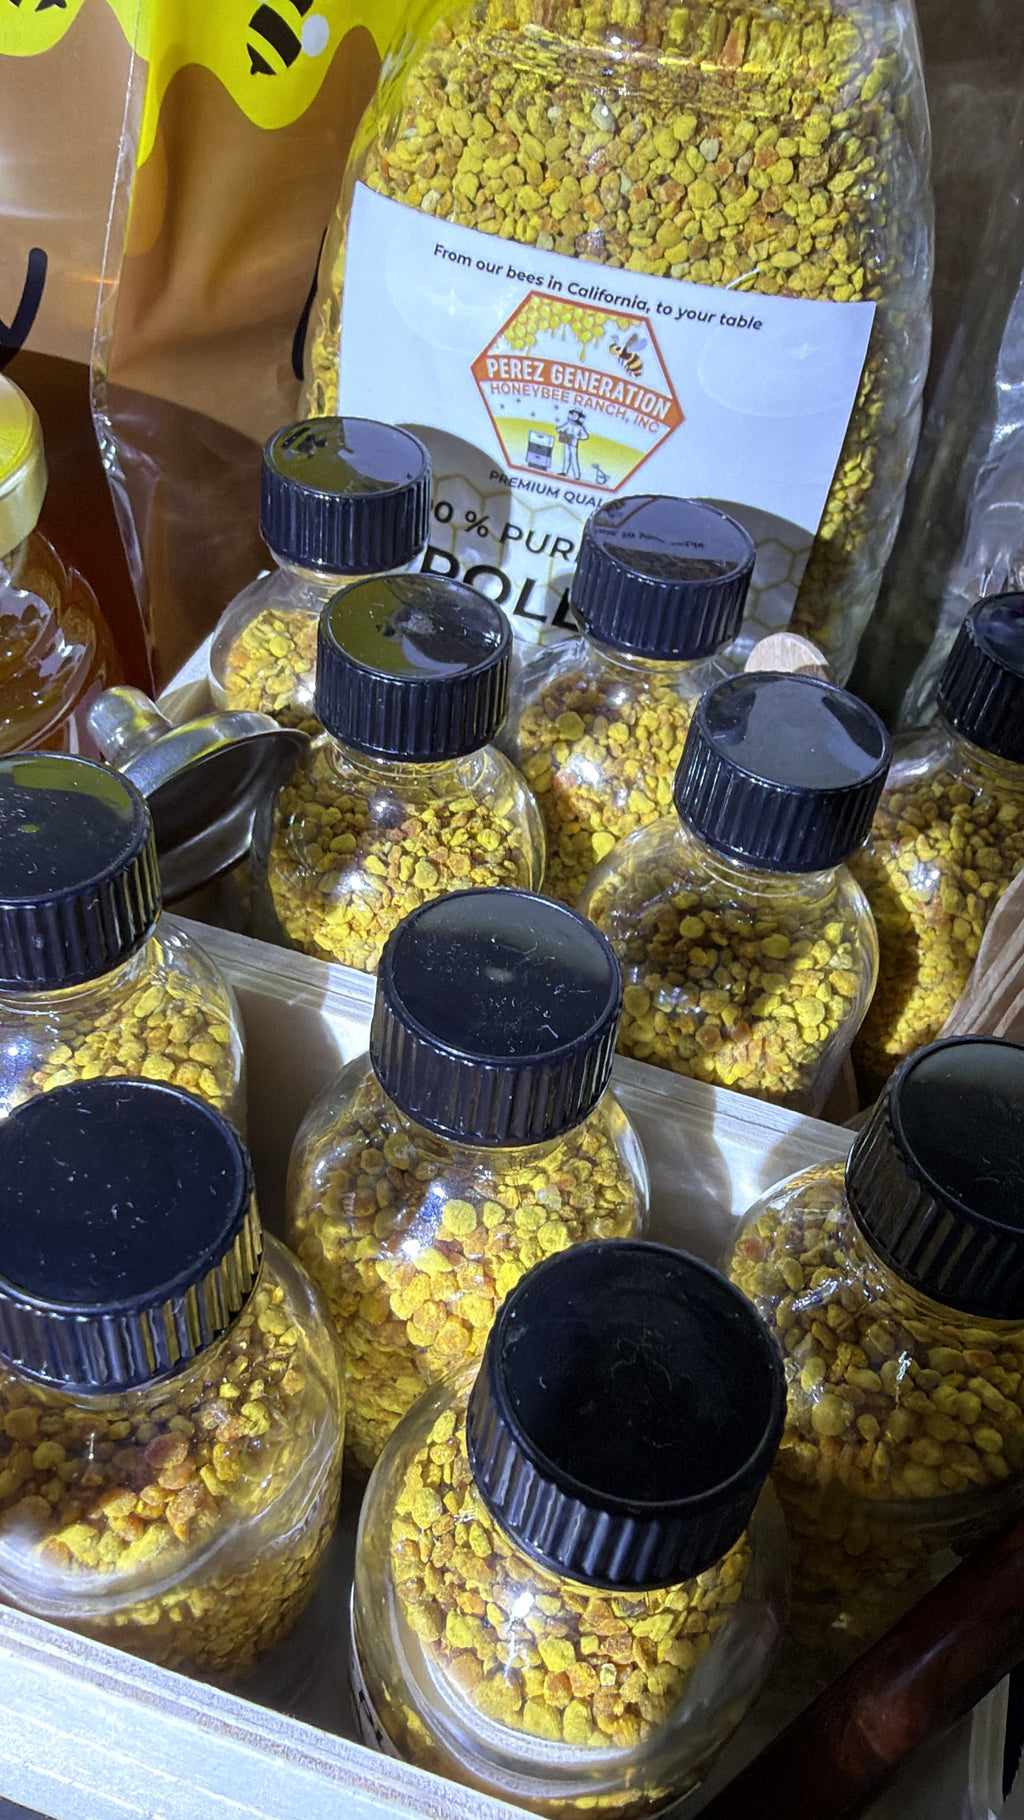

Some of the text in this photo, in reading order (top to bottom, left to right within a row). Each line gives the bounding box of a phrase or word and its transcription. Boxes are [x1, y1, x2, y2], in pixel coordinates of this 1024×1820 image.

[433, 243, 763, 331] From our bees in California, to your table
[486, 358, 672, 421] PEREZ GENERATION
[490, 382, 660, 434] HONEYBEE RANCH, INC
[489, 470, 560, 499] PREMIUM
[465, 510, 489, 538] %
[500, 522, 578, 563] PUR
